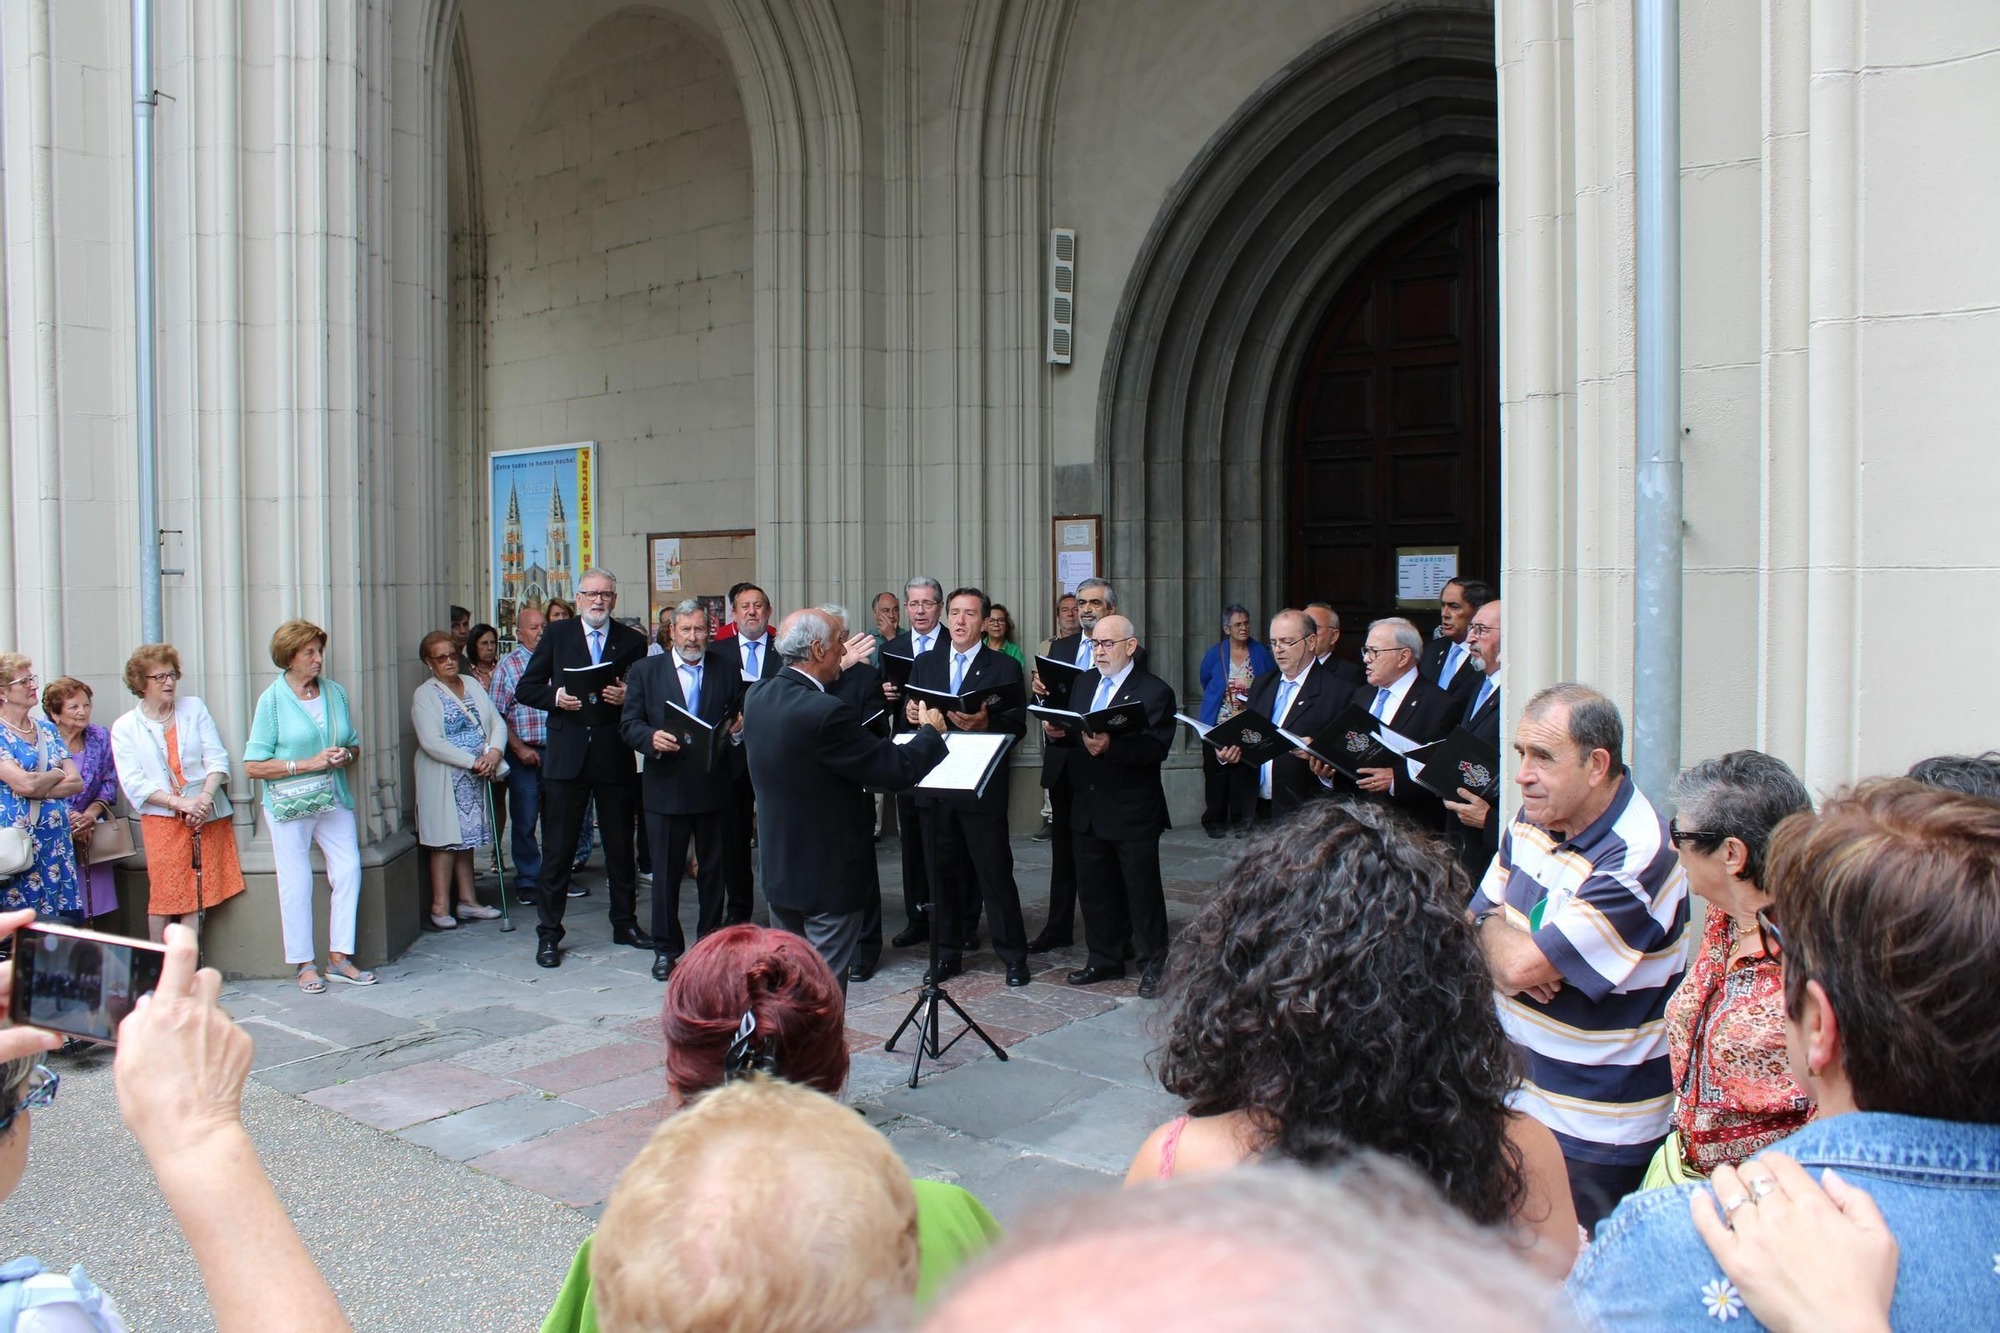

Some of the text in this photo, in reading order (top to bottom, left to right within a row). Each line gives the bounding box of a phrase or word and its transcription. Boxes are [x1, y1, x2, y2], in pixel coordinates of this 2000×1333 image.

[581, 450, 591, 572] Parroquia de Sa
